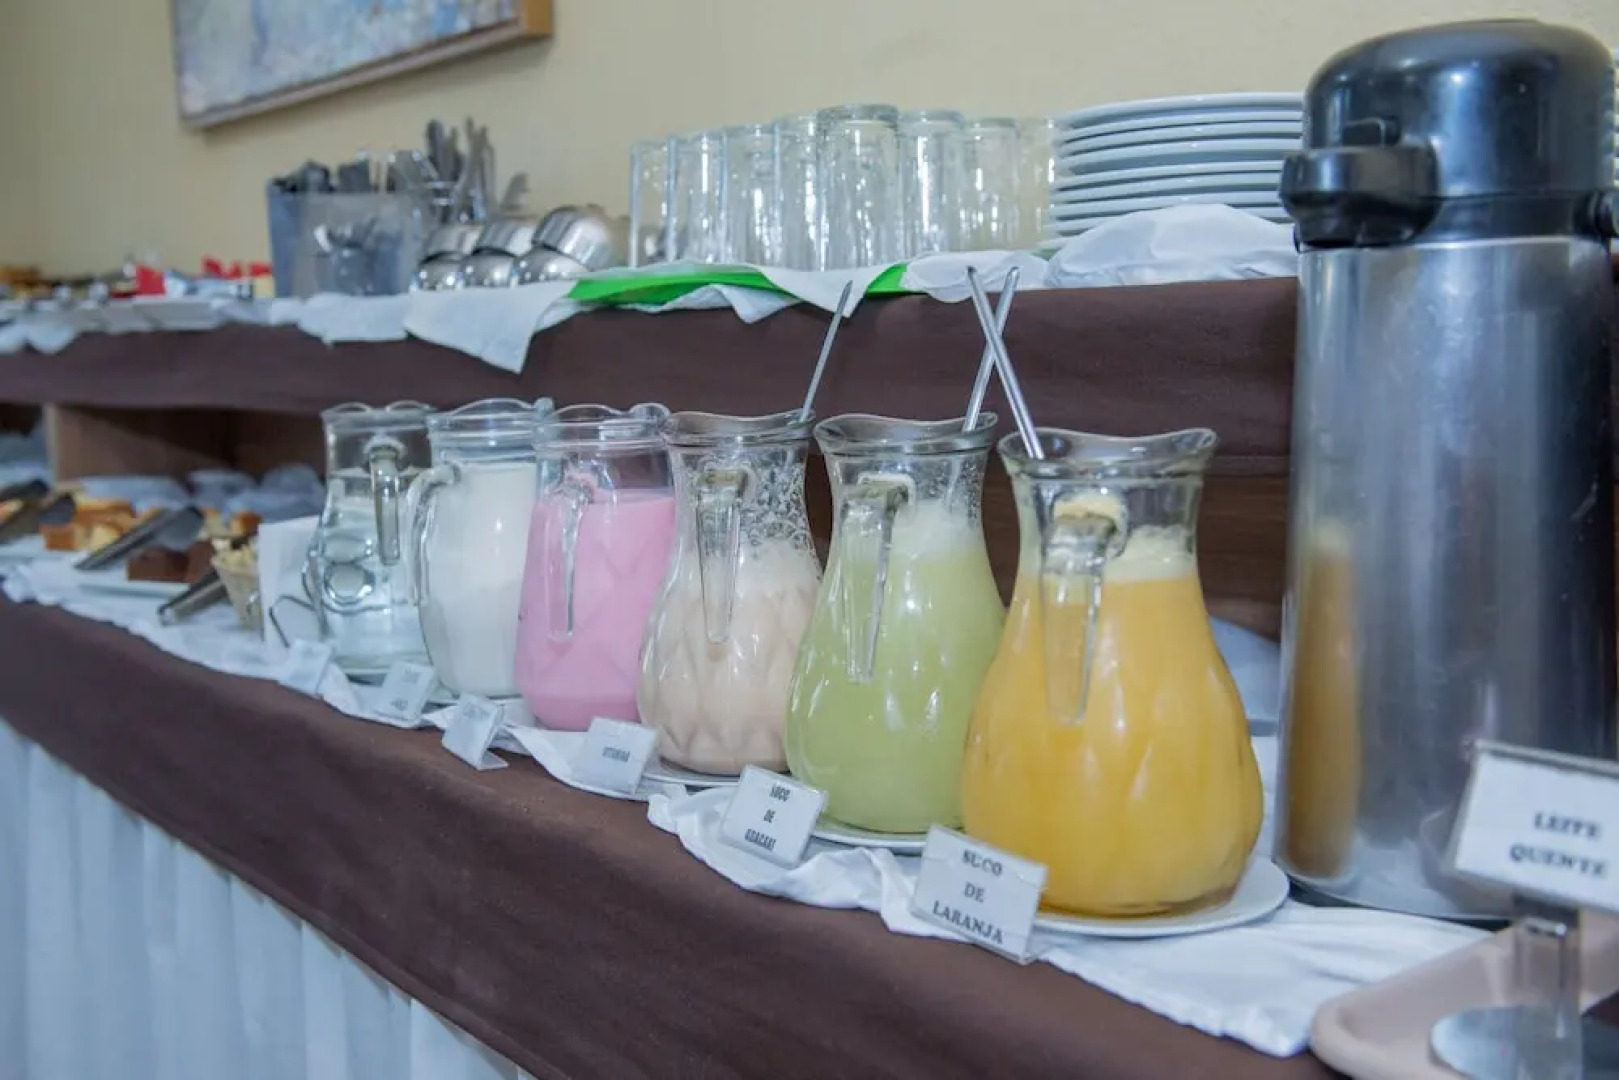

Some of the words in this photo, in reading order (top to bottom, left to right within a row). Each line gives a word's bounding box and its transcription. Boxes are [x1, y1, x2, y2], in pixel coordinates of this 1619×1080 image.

[1534, 812, 1600, 838] LEITE
[962, 849, 1003, 876] SUCO
[964, 881, 985, 902] DE
[932, 900, 1003, 944] LARANJA
